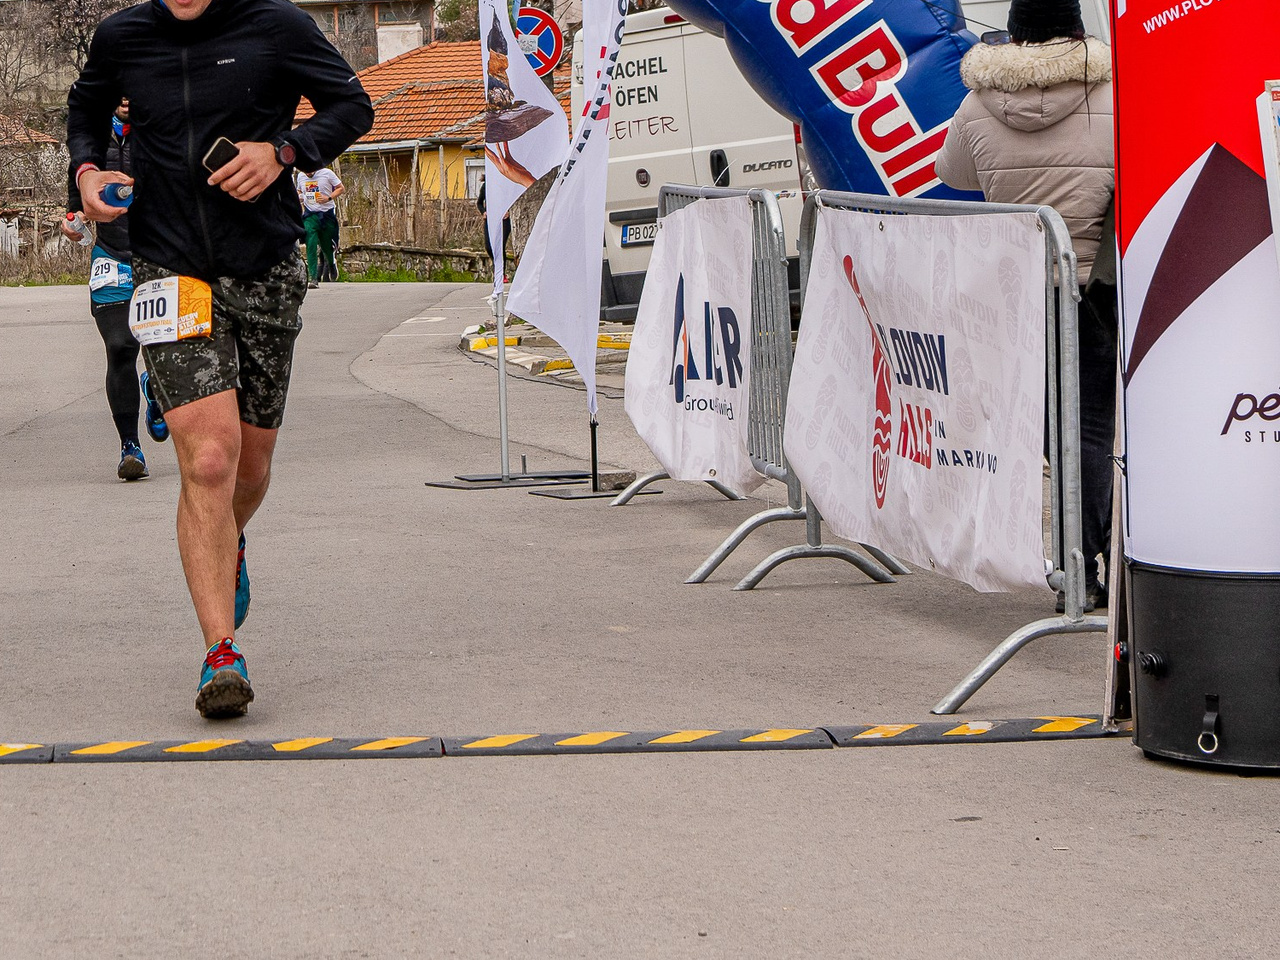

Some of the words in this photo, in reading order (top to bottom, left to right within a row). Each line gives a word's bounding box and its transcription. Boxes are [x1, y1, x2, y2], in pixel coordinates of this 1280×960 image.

[611, 56, 668, 81] ACHEL
[615, 85, 659, 107] ÖFEN
[809, 19, 948, 199] Bull
[609, 115, 679, 140] EITER
[742, 159, 793, 174] DUCATO
[628, 226, 641, 241] PB
[94, 262, 111, 276] 219
[135, 296, 167, 322] 1110
[934, 419, 947, 439] IN
